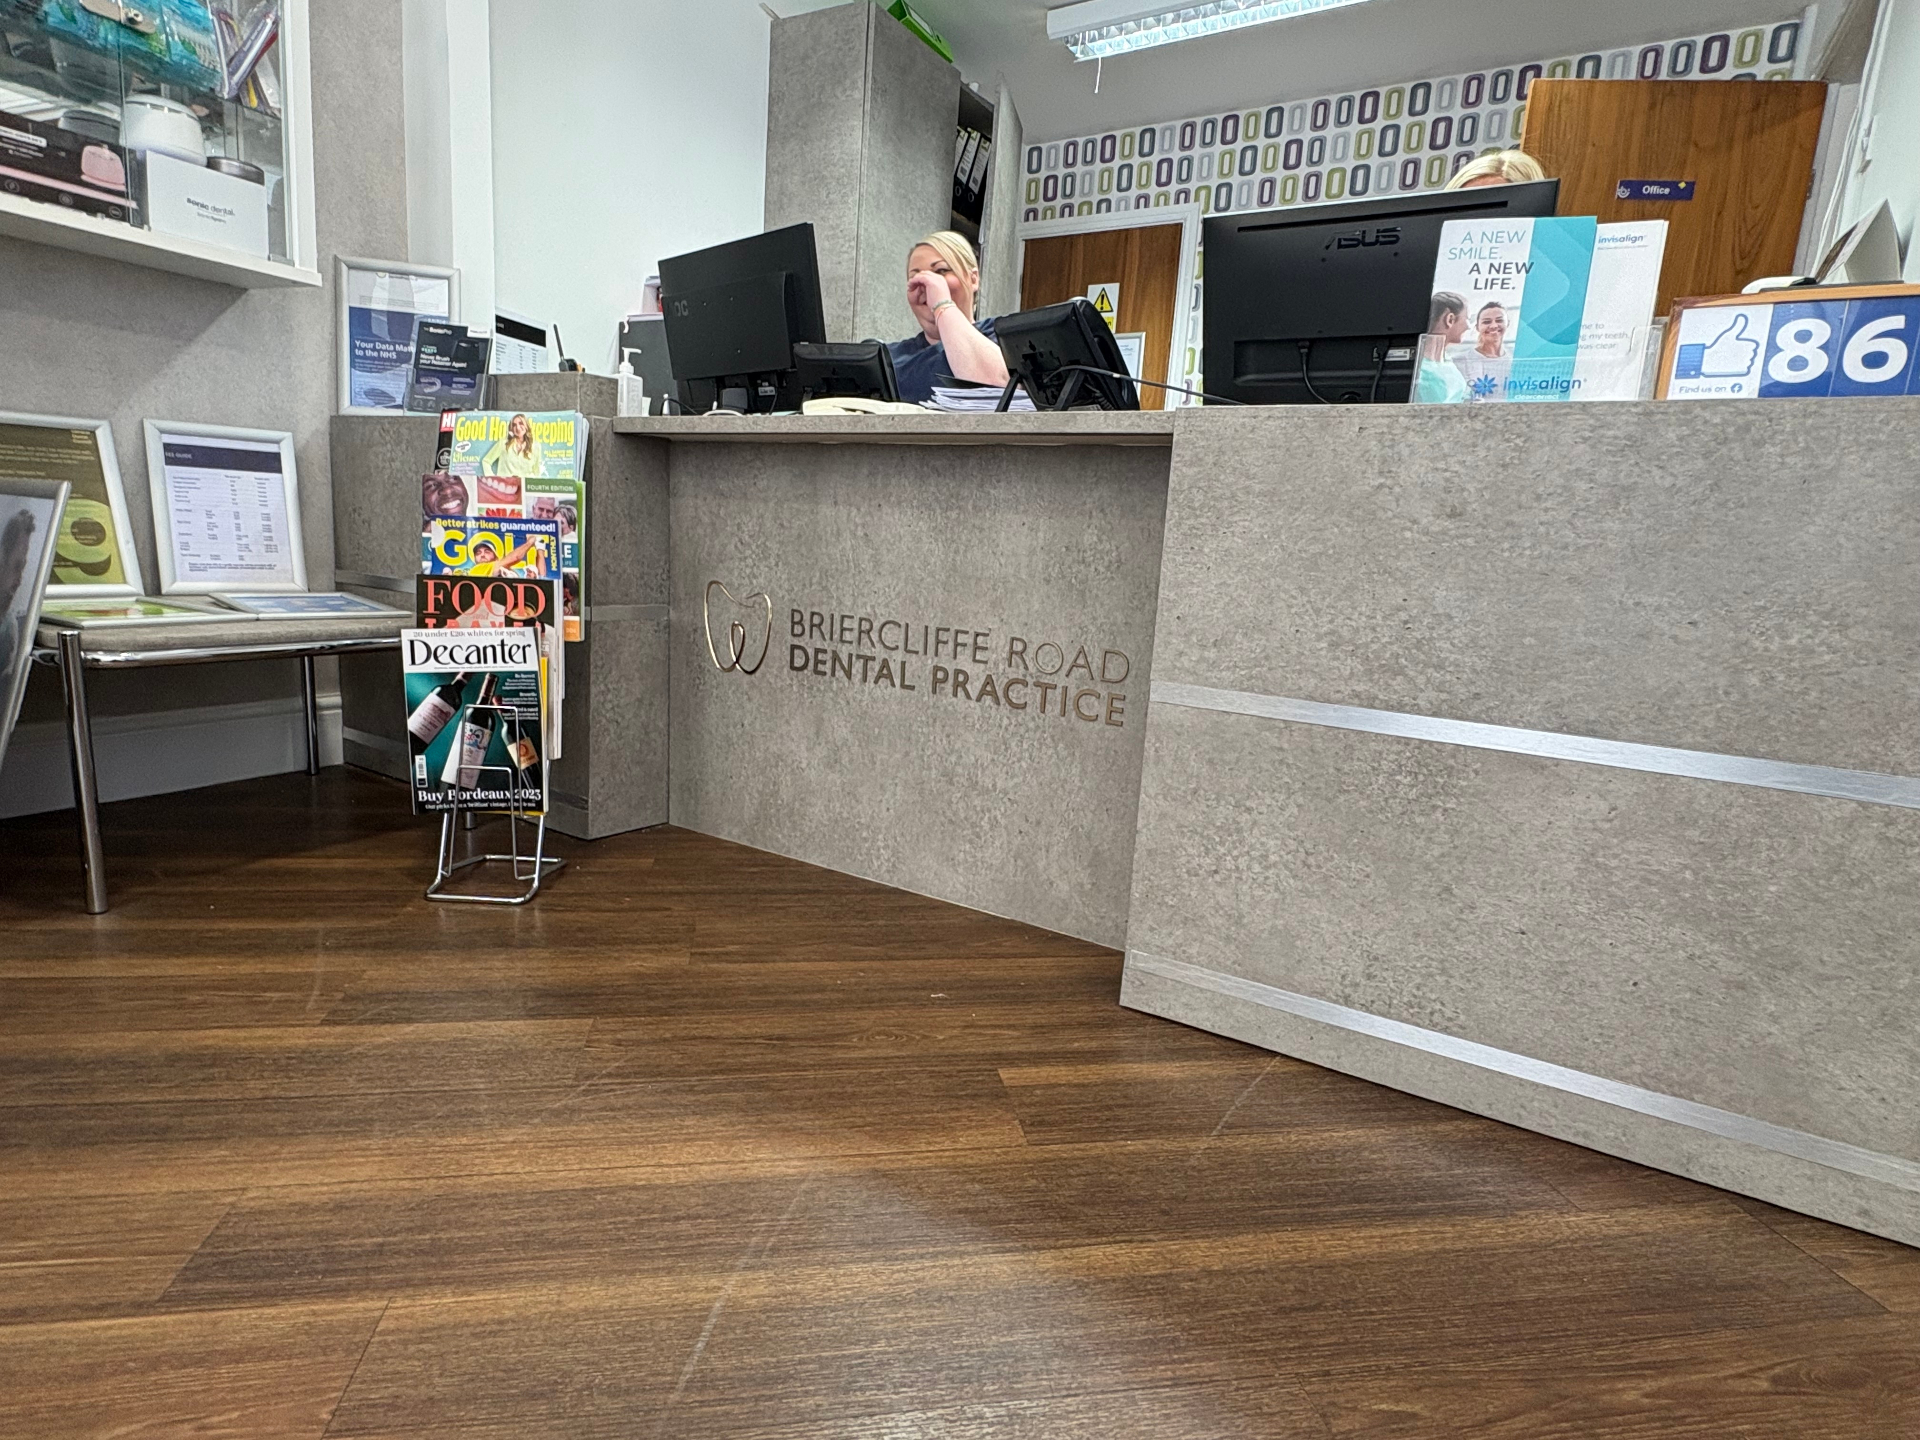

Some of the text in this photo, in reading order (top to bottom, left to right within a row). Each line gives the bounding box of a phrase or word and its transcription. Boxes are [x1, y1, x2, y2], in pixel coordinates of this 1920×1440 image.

[1641, 185, 1671, 195] Office
[1325, 226, 1401, 250] ASUS
[1460, 230, 1527, 245] A NEW
[1597, 234, 1644, 244] invisalign
[1448, 246, 1503, 260] SMILE.
[1468, 261, 1535, 275] A NEW
[1473, 277, 1516, 290] LIFE.
[354, 340, 374, 349] Your
[375, 341, 394, 351] Data
[355, 348, 397, 359] to the NHS
[1503, 376, 1581, 393] invisalign
[1679, 385, 1700, 394] Find
[455, 416, 487, 442] Good
[466, 519, 499, 530] strikes
[501, 521, 556, 532] guaranteed!
[435, 529, 550, 569] GOLF
[423, 579, 546, 618] FOOD
[424, 630, 448, 638] under
[467, 629, 492, 637] whites
[494, 629, 505, 637] for
[506, 629, 526, 638] spring
[408, 638, 532, 666] Decanter
[790, 608, 1130, 684] BRIERCLIFFE ROAD
[789, 644, 1127, 727] DENTAL PRACTICE
[418, 788, 541, 804] Buy Bordeaux 2023
